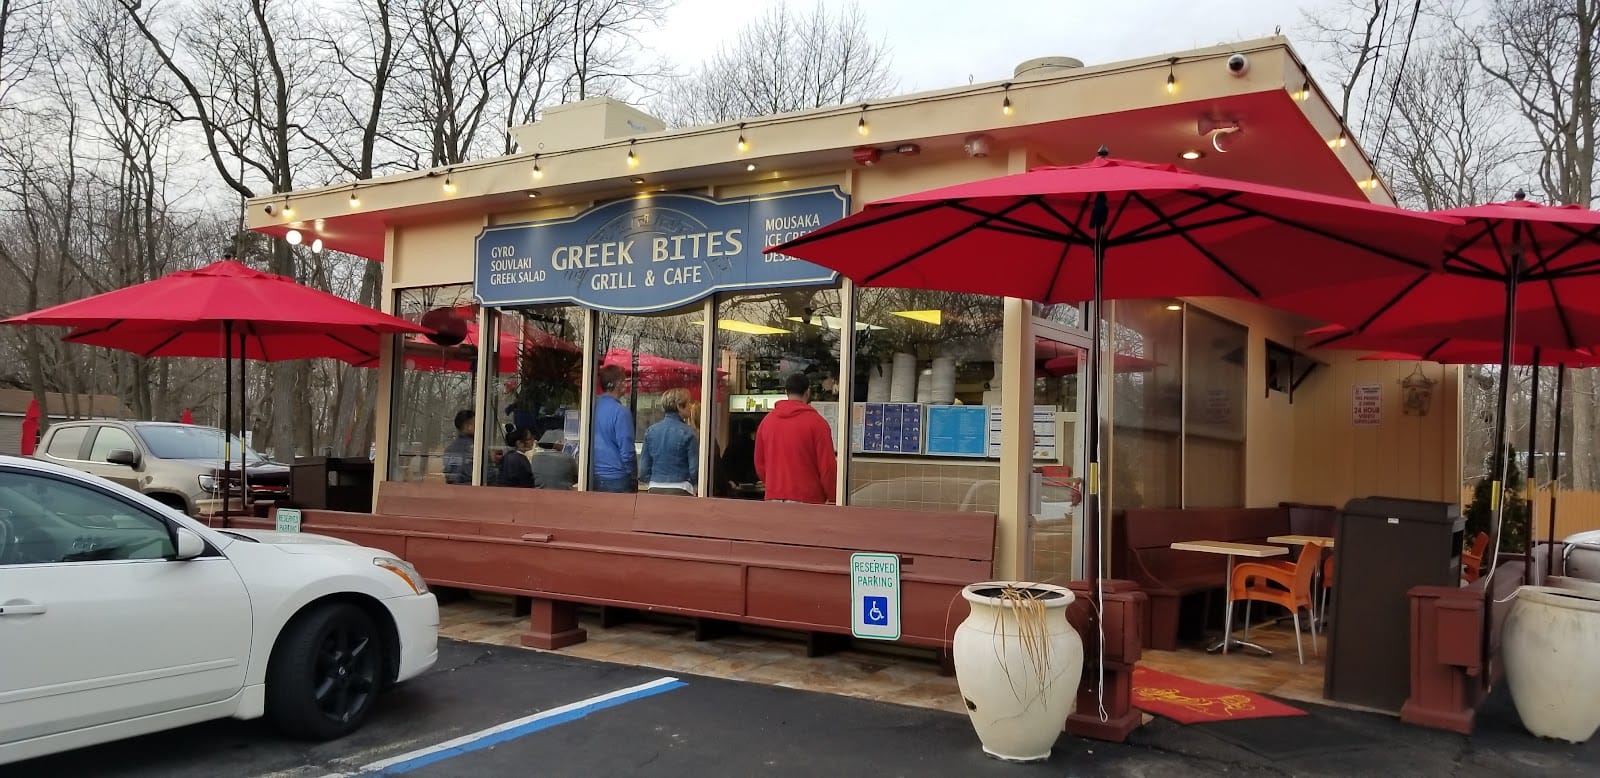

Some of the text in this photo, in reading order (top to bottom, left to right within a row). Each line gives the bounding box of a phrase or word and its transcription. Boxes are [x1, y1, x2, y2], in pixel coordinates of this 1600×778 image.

[765, 213, 820, 231] MOUSAKA
[765, 233, 782, 248] ICE
[491, 245, 515, 258] GYRO
[551, 229, 743, 271] GREEK BITES
[490, 257, 532, 271] SOUVLAKI
[490, 270, 546, 285] GREEK SALAD
[591, 265, 702, 291] GRILL & CAFE
[854, 561, 895, 573] RESERVED
[857, 576, 893, 588] PARKING
